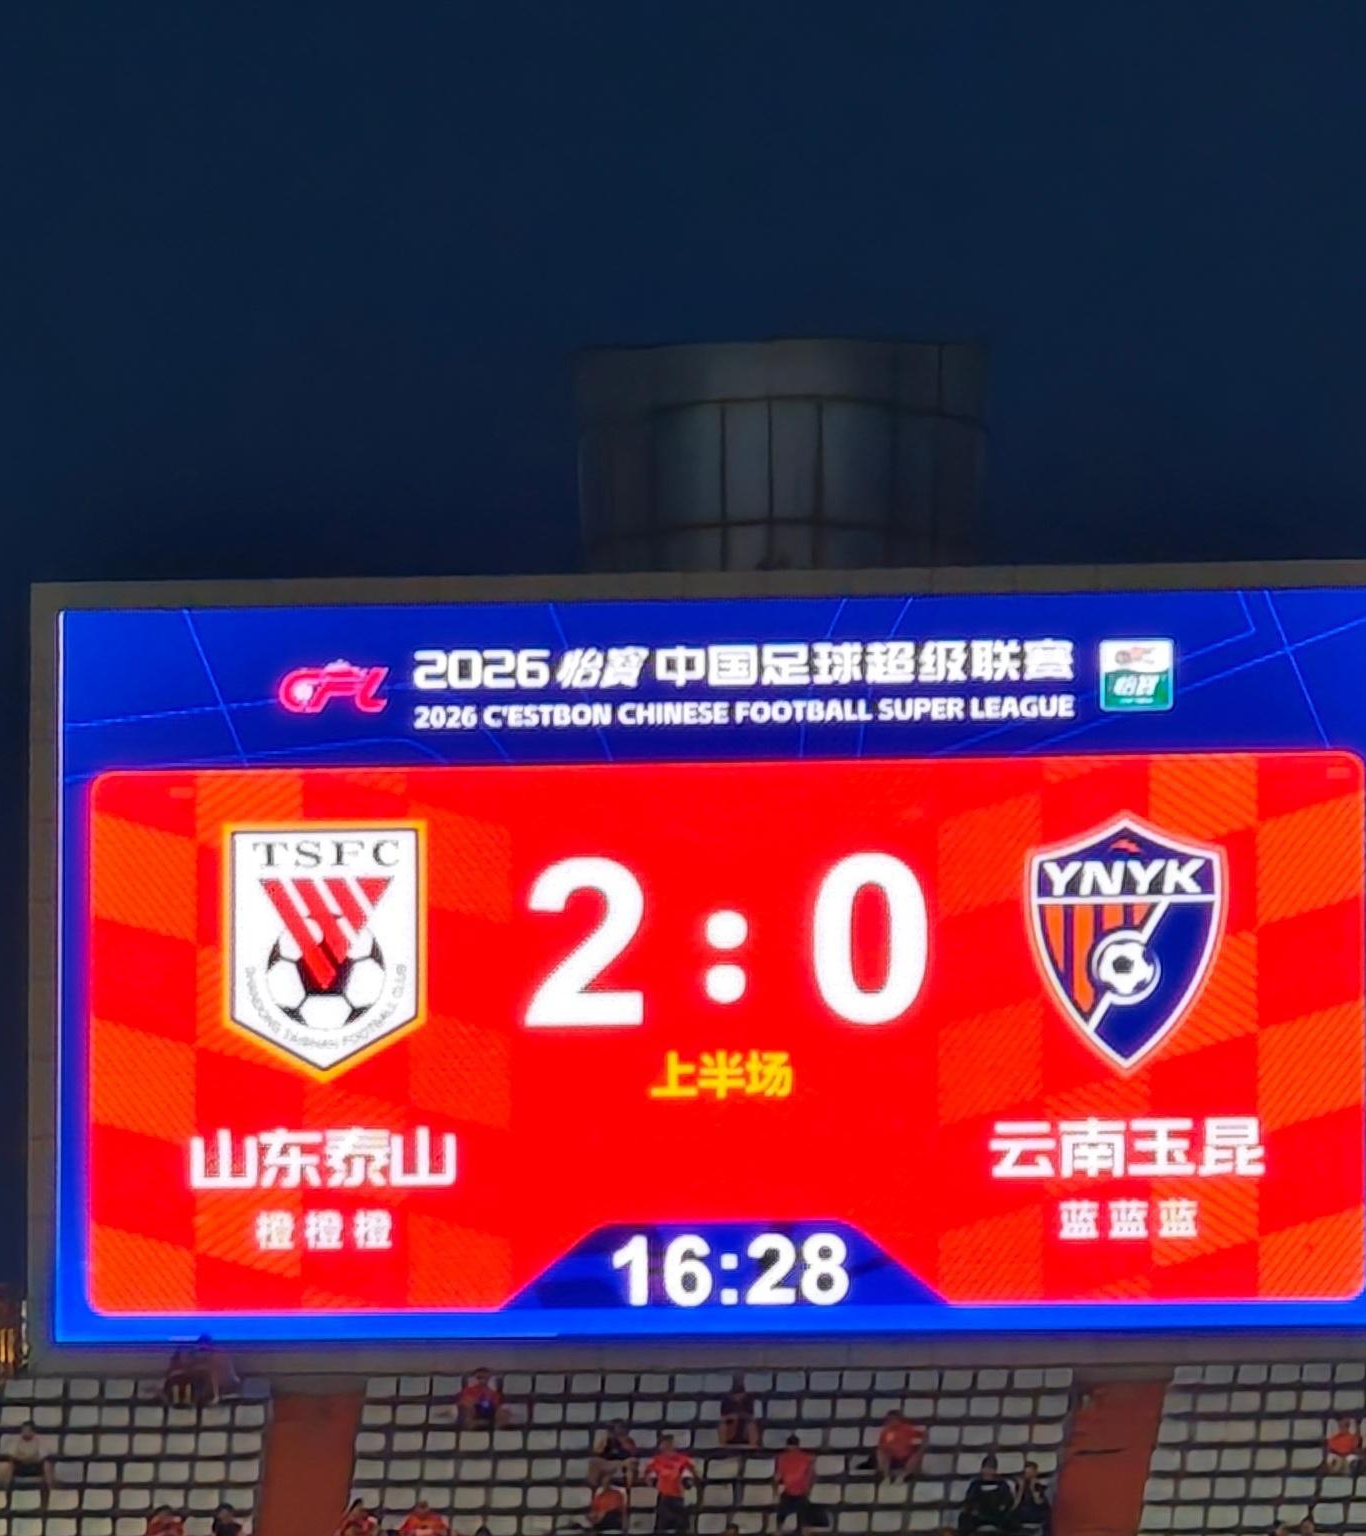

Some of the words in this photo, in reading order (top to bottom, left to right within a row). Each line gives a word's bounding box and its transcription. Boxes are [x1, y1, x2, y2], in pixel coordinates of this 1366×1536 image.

[412, 705, 478, 730] 2026
[483, 702, 613, 728] C'ESTBON
[617, 700, 729, 726] CHINESE
[735, 698, 873, 724] FOOTBALL
[878, 696, 965, 721] SUPER
[970, 693, 1075, 720] LEAGUE
[251, 839, 401, 869] TSFC
[1041, 858, 1207, 897] YNYK
[649, 1050, 793, 1099] 上半场
[189, 1124, 458, 1190] 山东泰山
[988, 1115, 1266, 1179] 云南玉昆
[611, 1232, 851, 1308] 16:28
